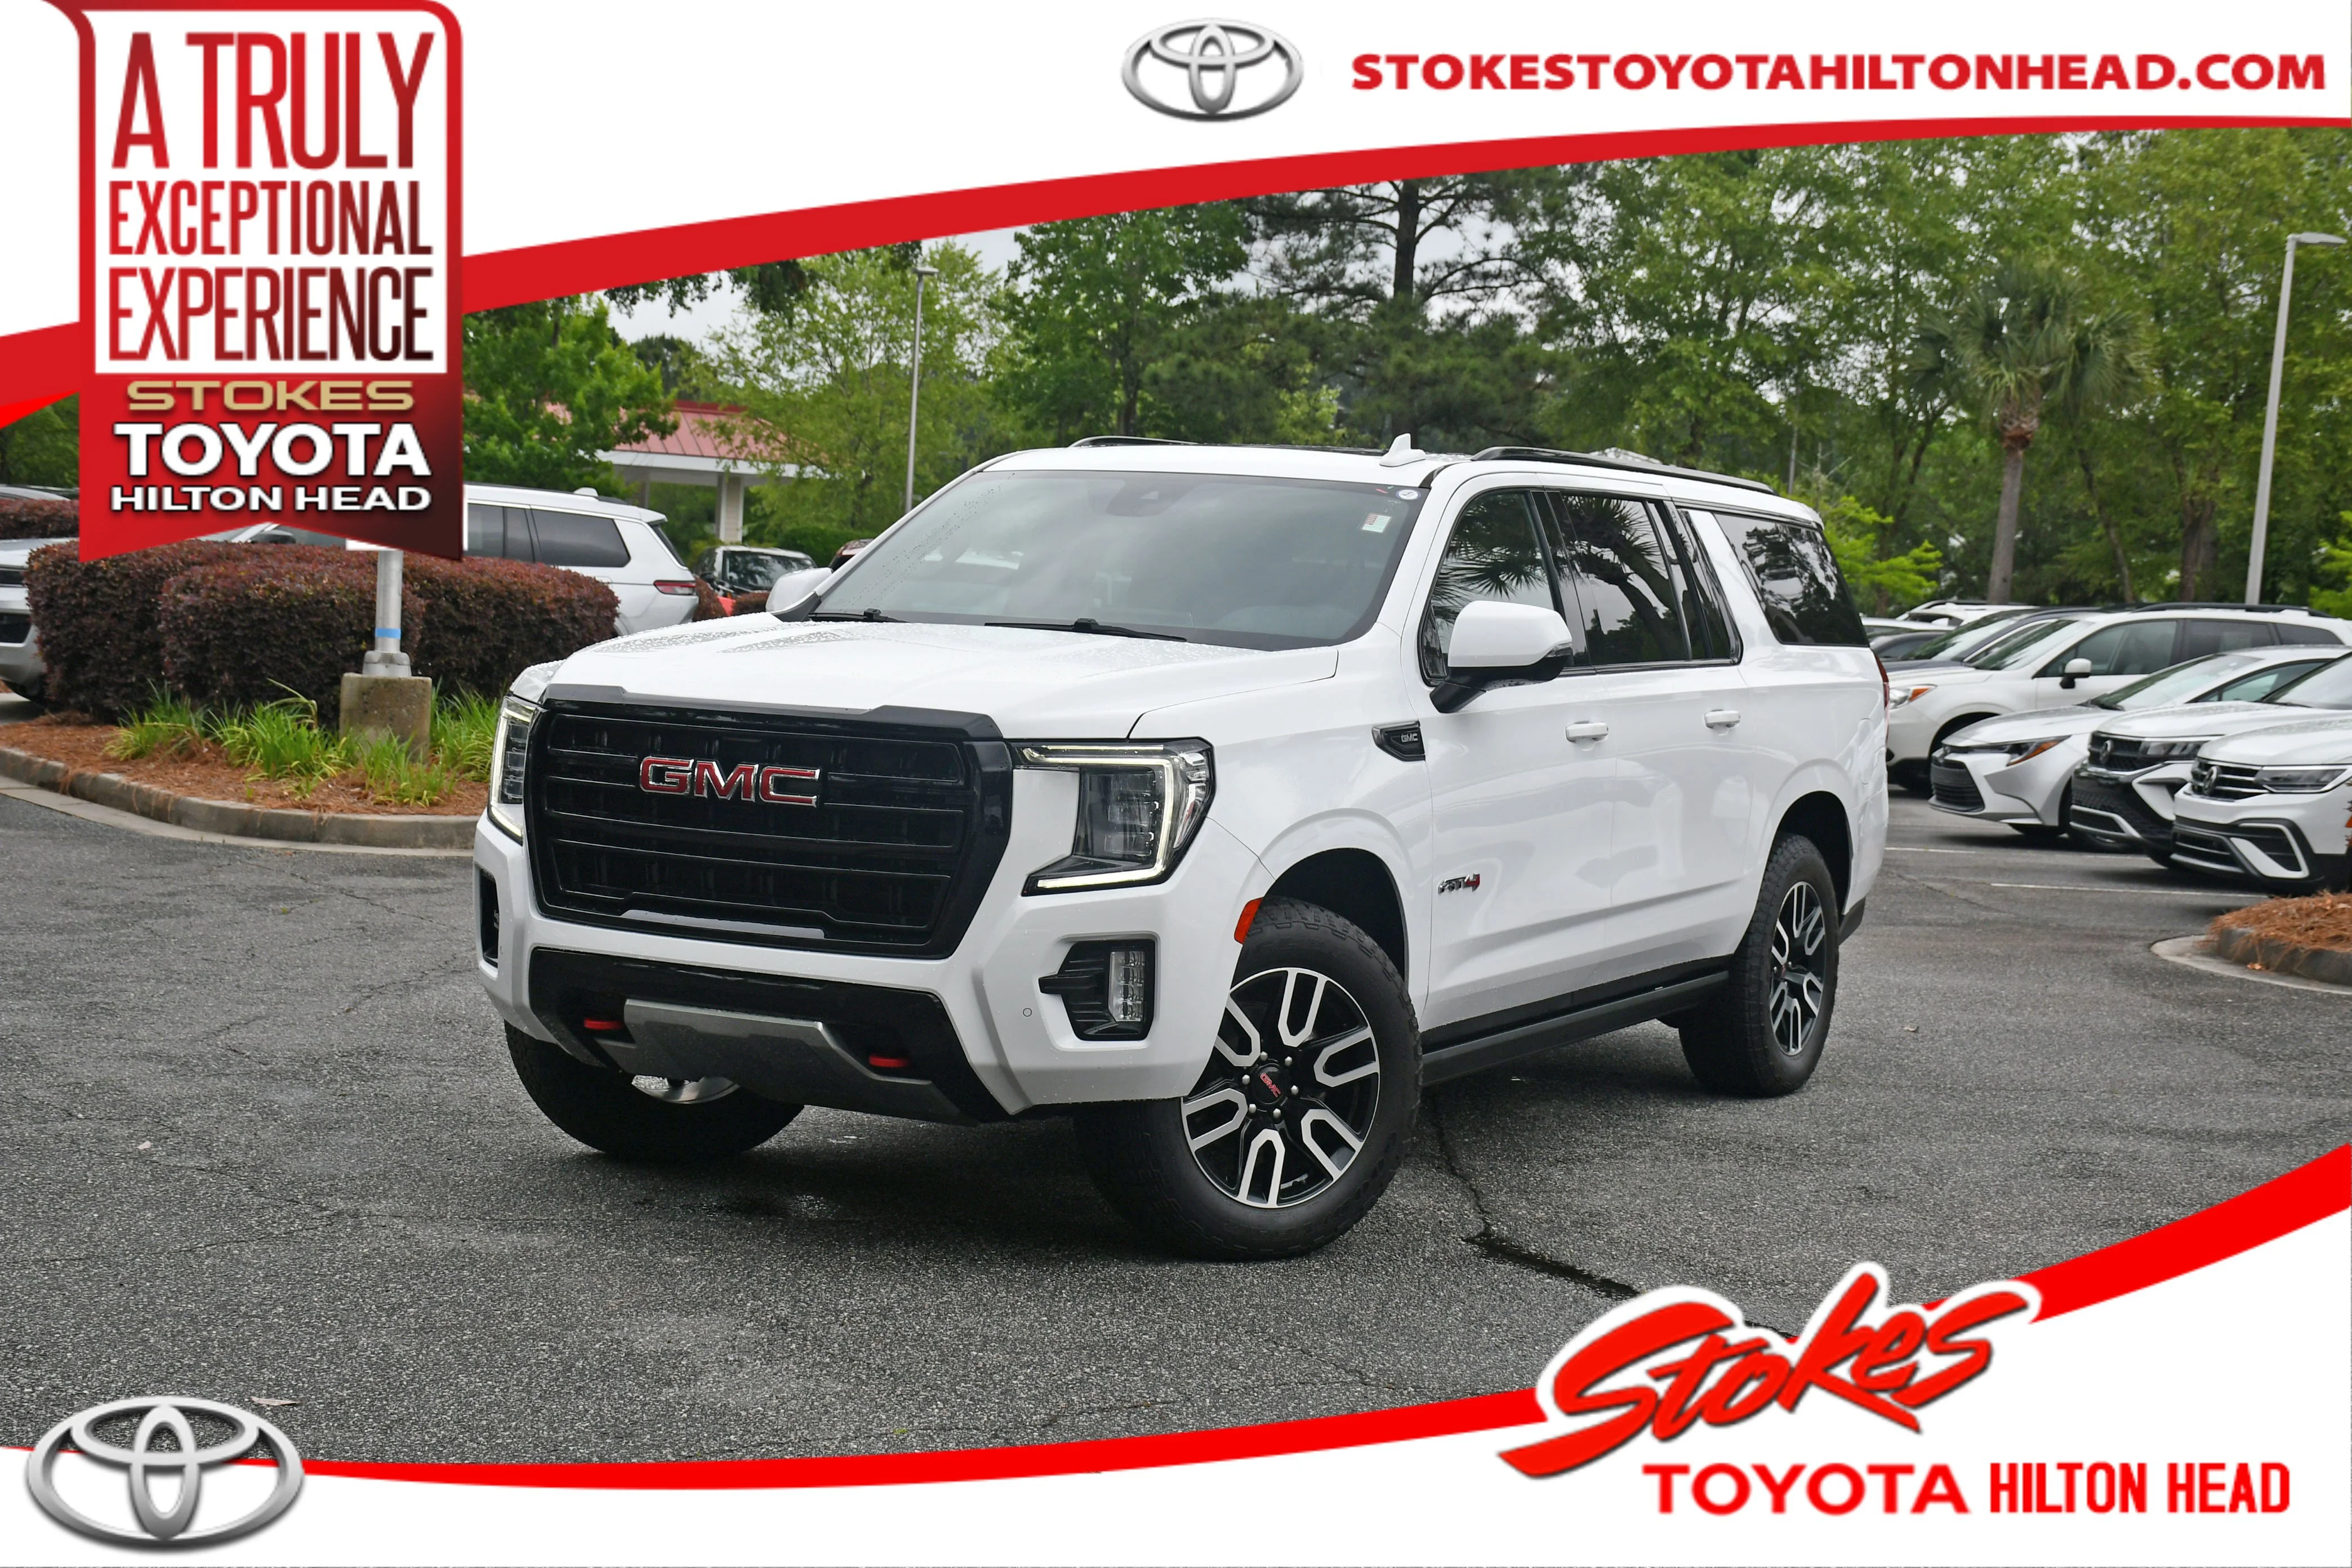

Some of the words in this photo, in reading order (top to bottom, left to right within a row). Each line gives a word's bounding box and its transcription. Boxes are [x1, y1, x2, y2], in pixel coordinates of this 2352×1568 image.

[1401, 733, 1418, 742] GMC
[640, 756, 820, 808] GMC
[1260, 1072, 1281, 1098] GMC
